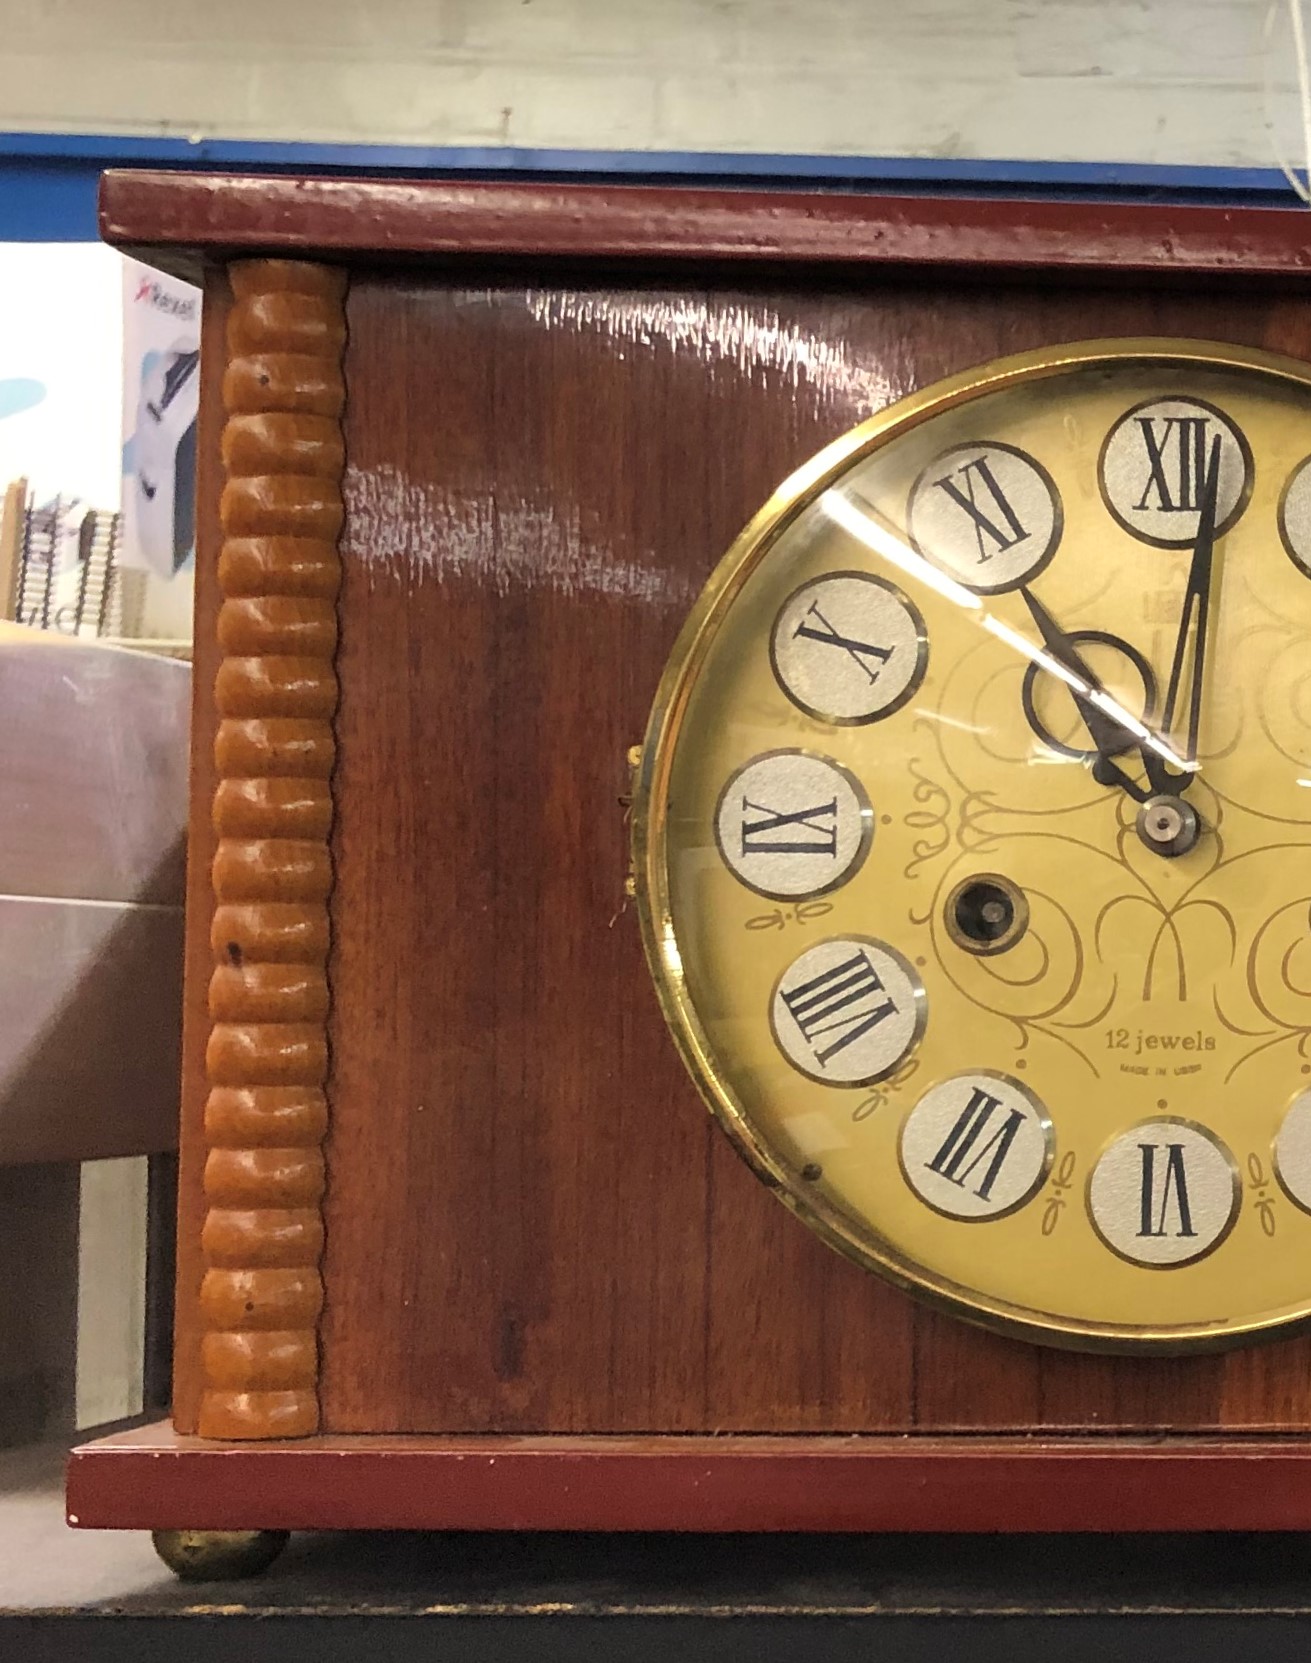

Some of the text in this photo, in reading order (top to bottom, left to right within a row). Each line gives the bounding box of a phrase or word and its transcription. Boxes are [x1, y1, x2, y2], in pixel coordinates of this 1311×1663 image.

[934, 456, 1031, 564] XI
[1132, 417, 1210, 512] XII
[793, 600, 896, 687] X
[742, 796, 838, 857] IX
[780, 948, 899, 1068] VIII
[1105, 1029, 1216, 1055] 12 jewels
[924, 1087, 1027, 1202] VII
[1136, 1144, 1198, 1237] VI
